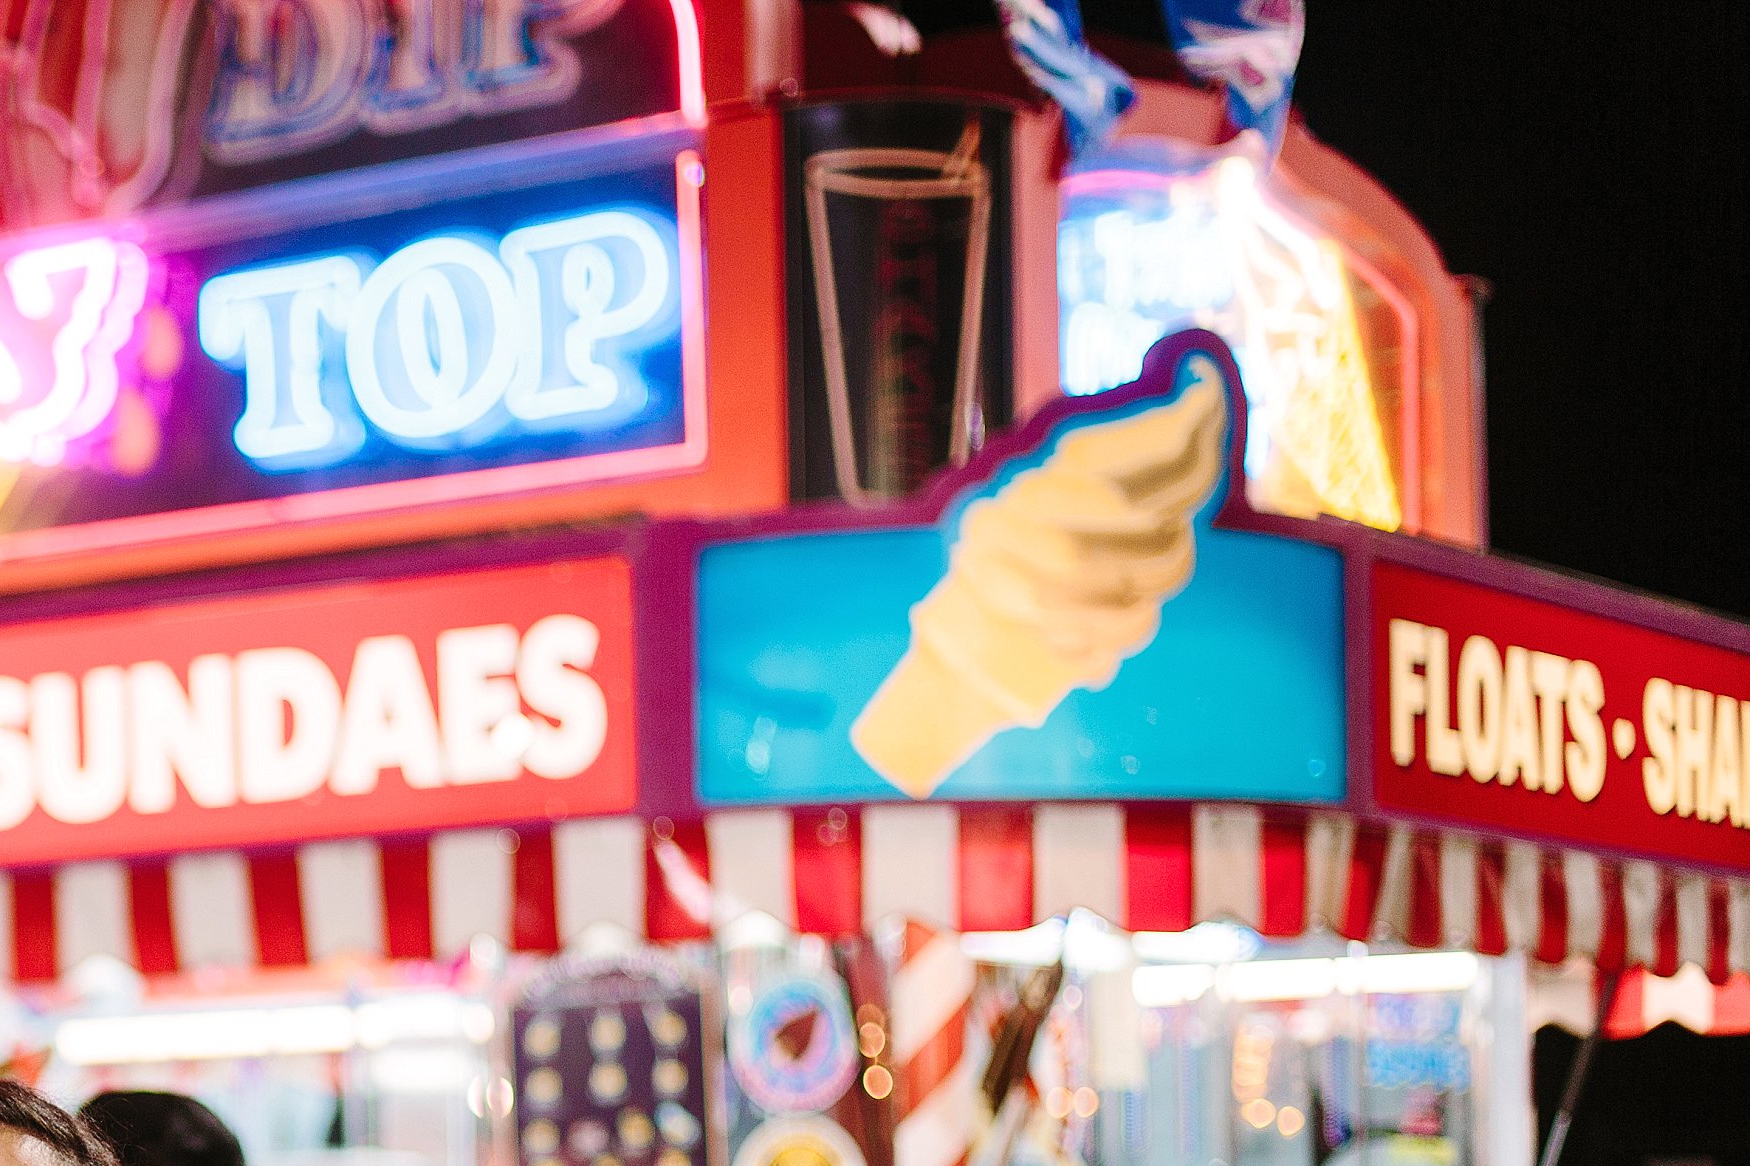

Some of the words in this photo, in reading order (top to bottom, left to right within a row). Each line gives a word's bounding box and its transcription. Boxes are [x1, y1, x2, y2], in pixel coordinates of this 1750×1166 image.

[198, 210, 672, 472] TOP
[1388, 617, 1608, 803] FLOATS
[1641, 676, 1750, 831] SHA
